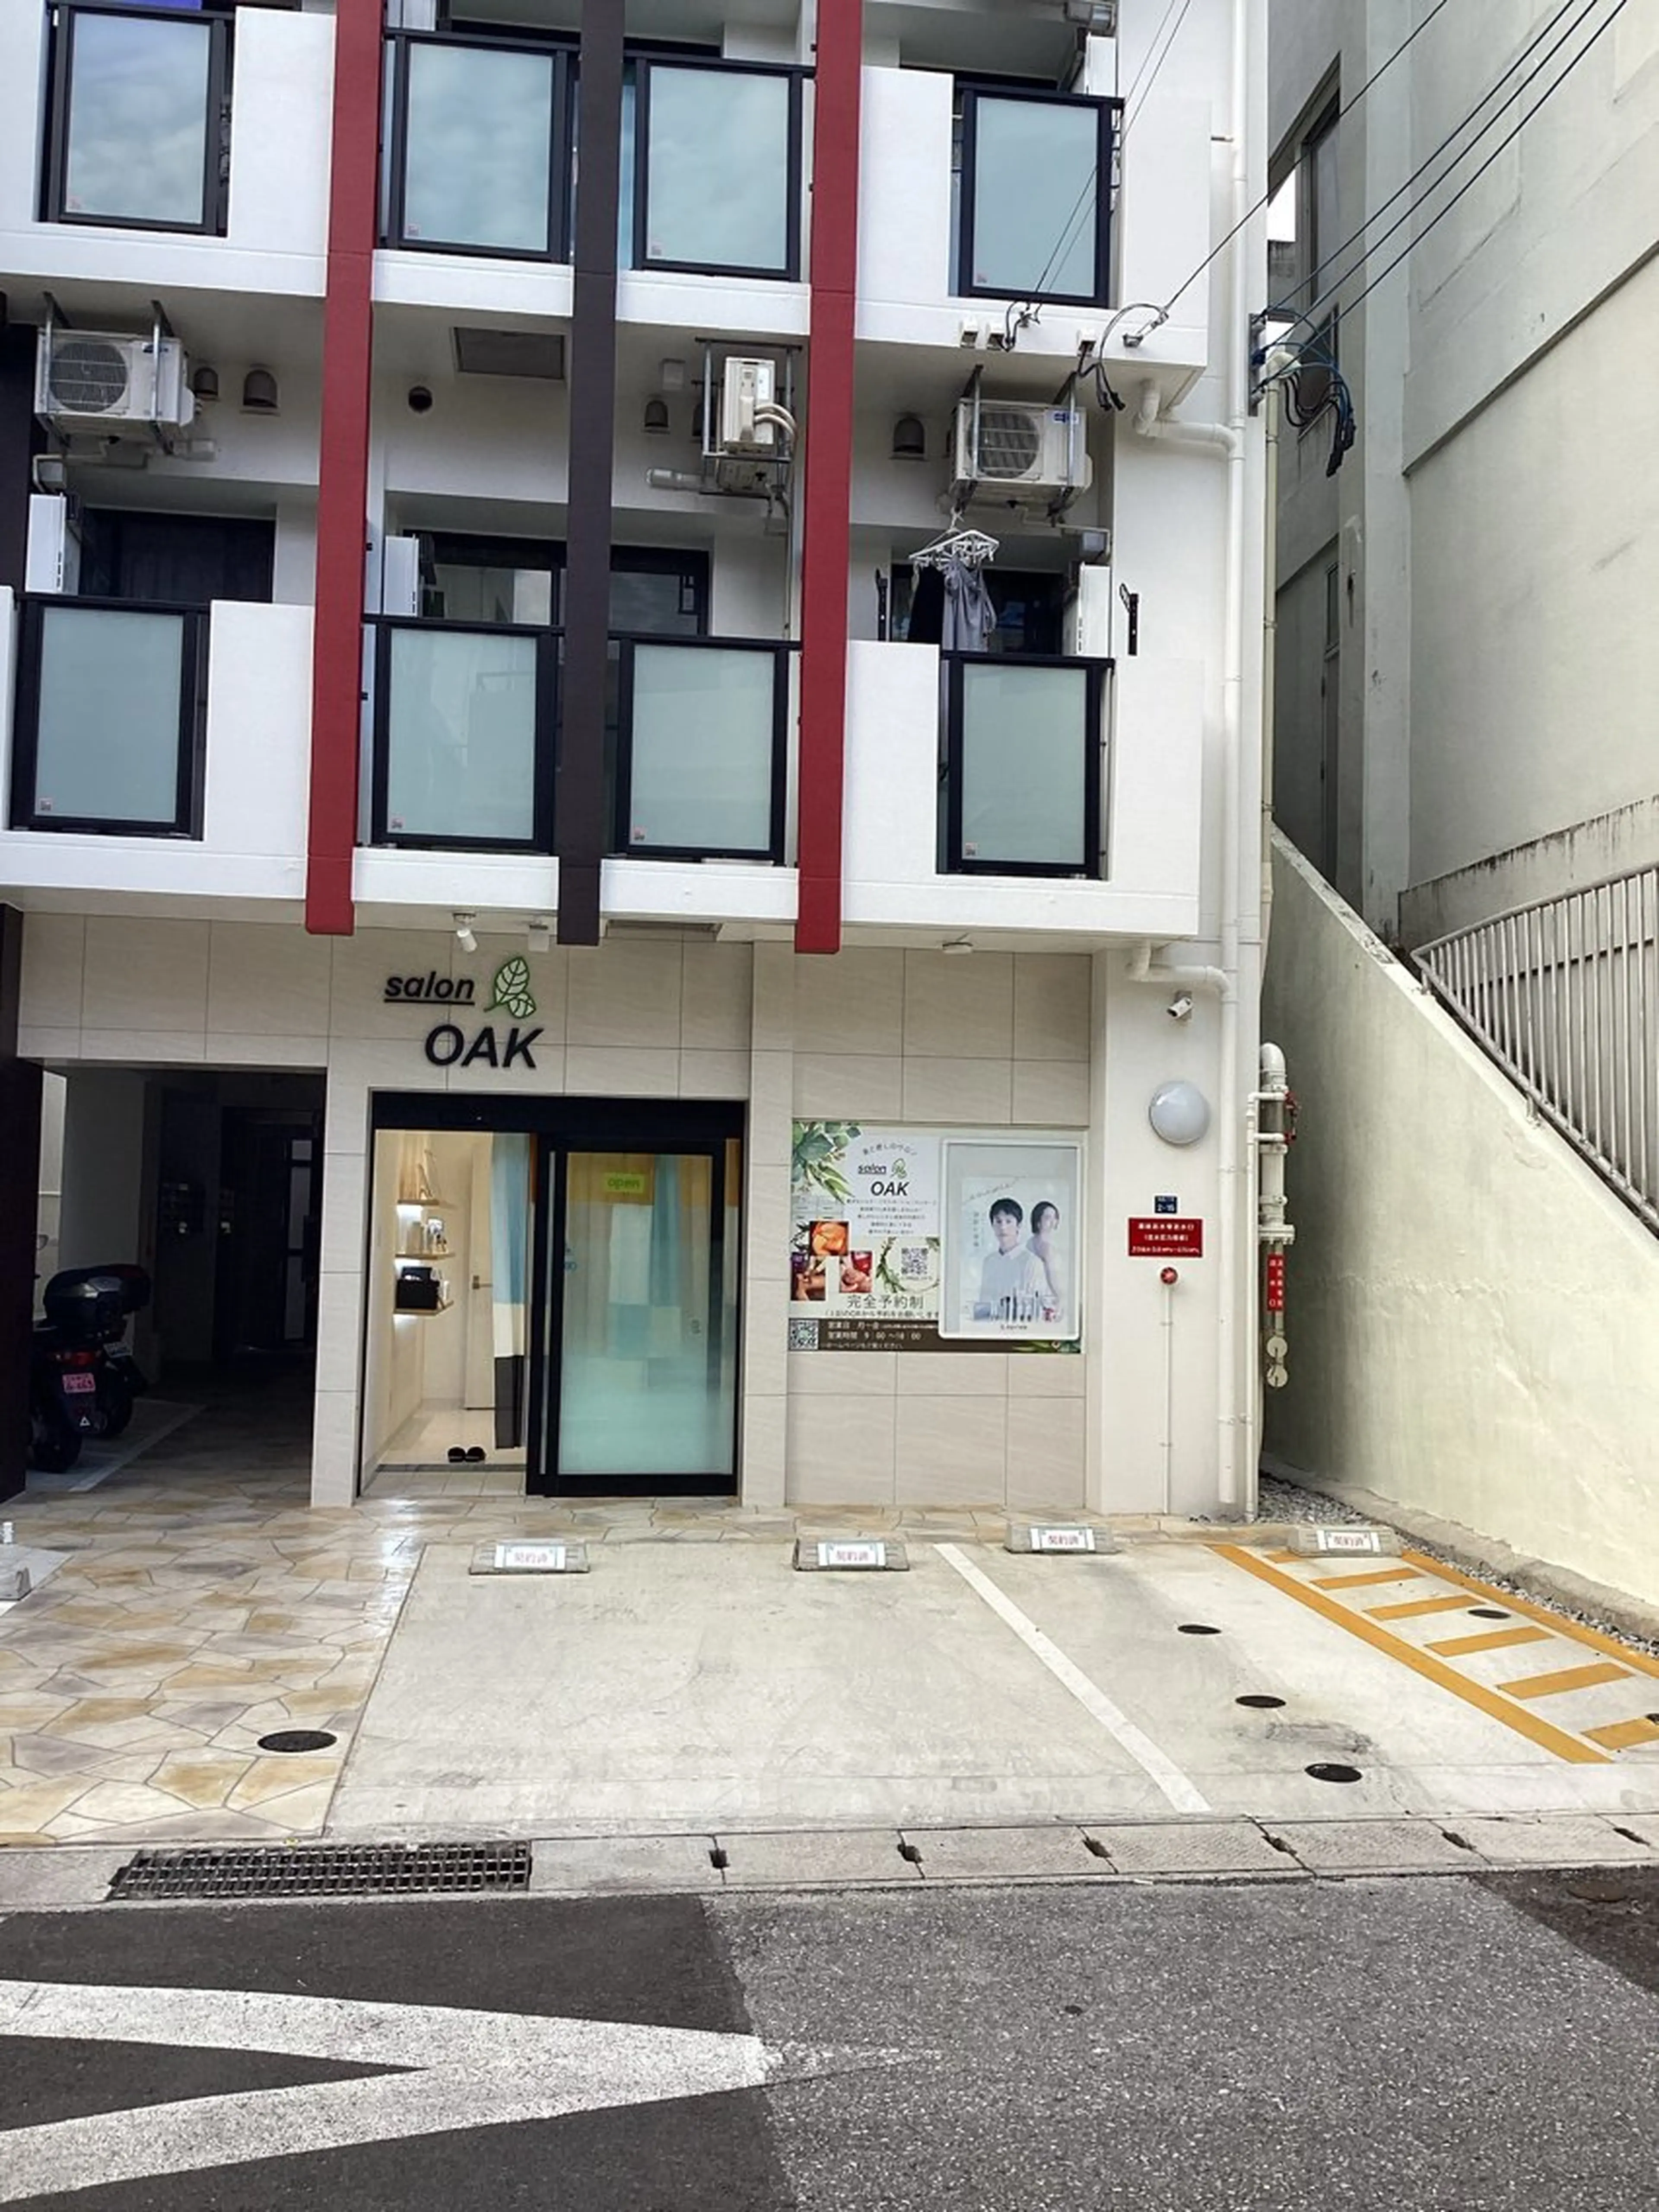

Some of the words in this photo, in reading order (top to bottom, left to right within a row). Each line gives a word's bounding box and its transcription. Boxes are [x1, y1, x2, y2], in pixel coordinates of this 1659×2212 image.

[385, 971, 475, 999] salon
[425, 1024, 544, 1069] OAK
[858, 1163, 887, 1174] salon
[607, 1178, 640, 1189] open
[871, 1181, 910, 1196] OAK
[847, 1294, 924, 1309] 完全予約制
